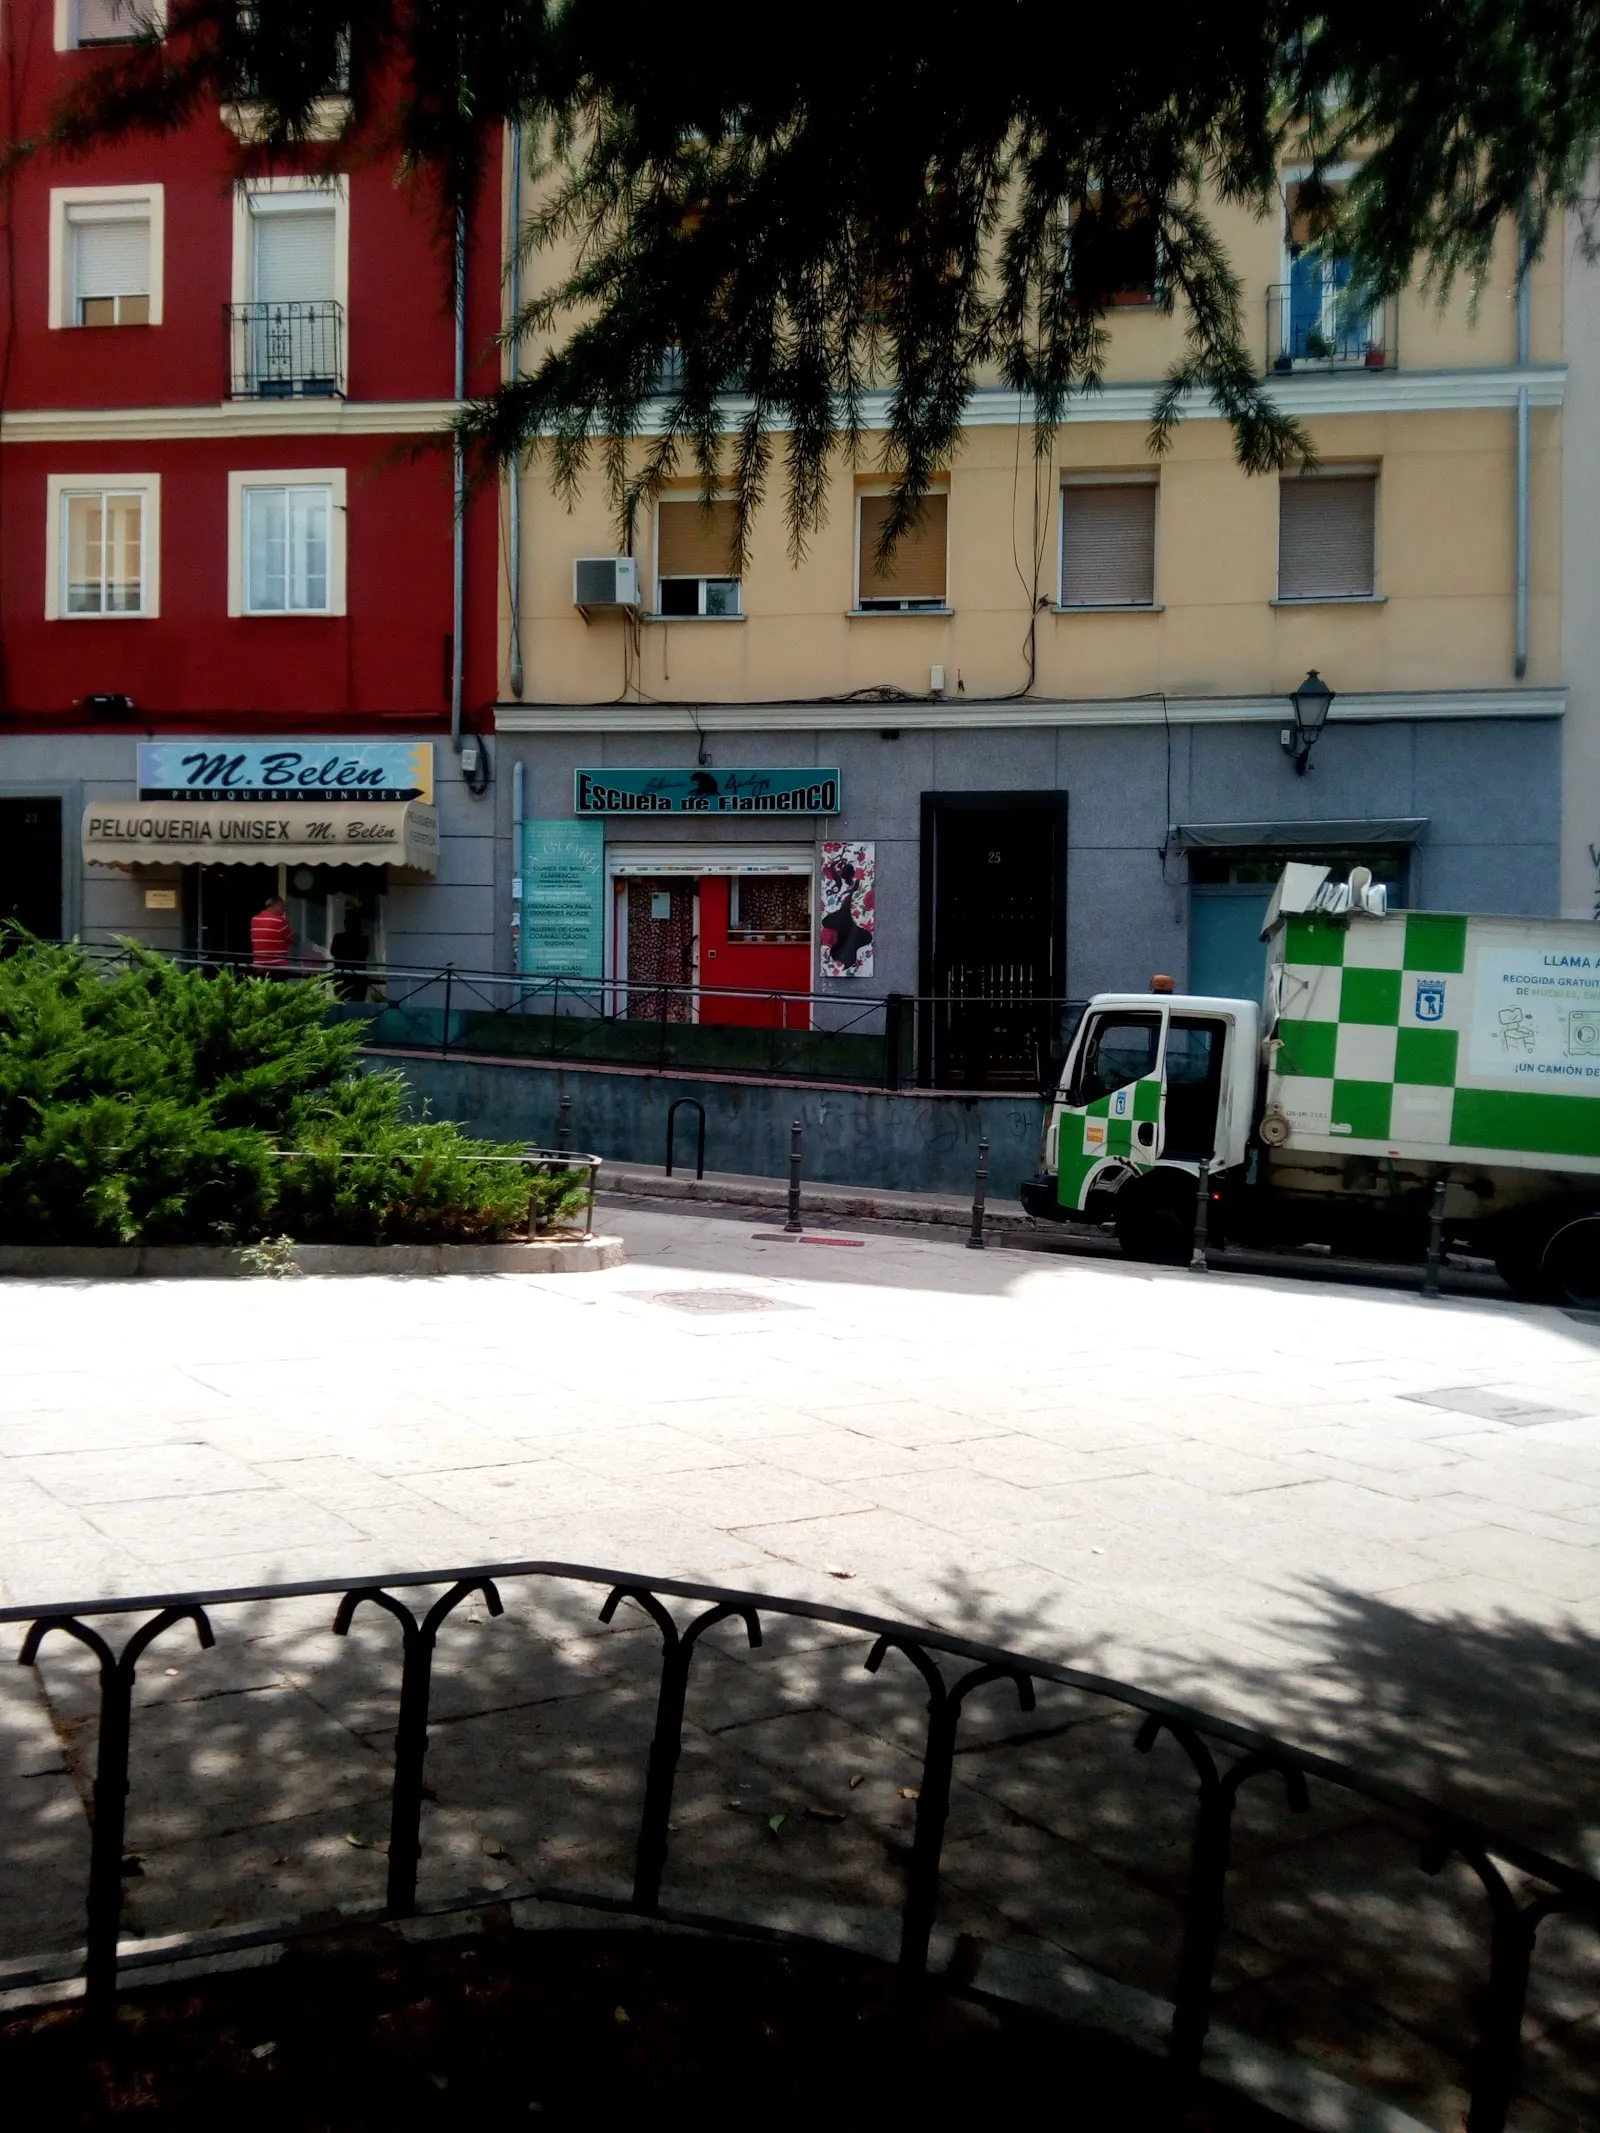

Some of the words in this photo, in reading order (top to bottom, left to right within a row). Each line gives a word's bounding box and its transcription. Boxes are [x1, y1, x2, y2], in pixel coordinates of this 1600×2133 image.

[181, 752, 253, 786] M.
[260, 752, 387, 786] Belén
[172, 791, 304, 800] PELUQUERIA
[325, 791, 401, 800] UNISEX
[578, 771, 672, 811] Escuela
[681, 796, 710, 811] de
[717, 779, 837, 811] Flamenco
[88, 818, 213, 841] PELUQUERIA
[219, 819, 291, 840] UNISEX
[305, 822, 337, 839] M.
[346, 821, 397, 839] Belén
[988, 851, 1002, 865] 25
[1544, 955, 1592, 969] LLAMA
[1503, 974, 1556, 986] RECOGIDA
[1516, 987, 1530, 996] DE
[1538, 1064, 1582, 1076] CAMIÓN
